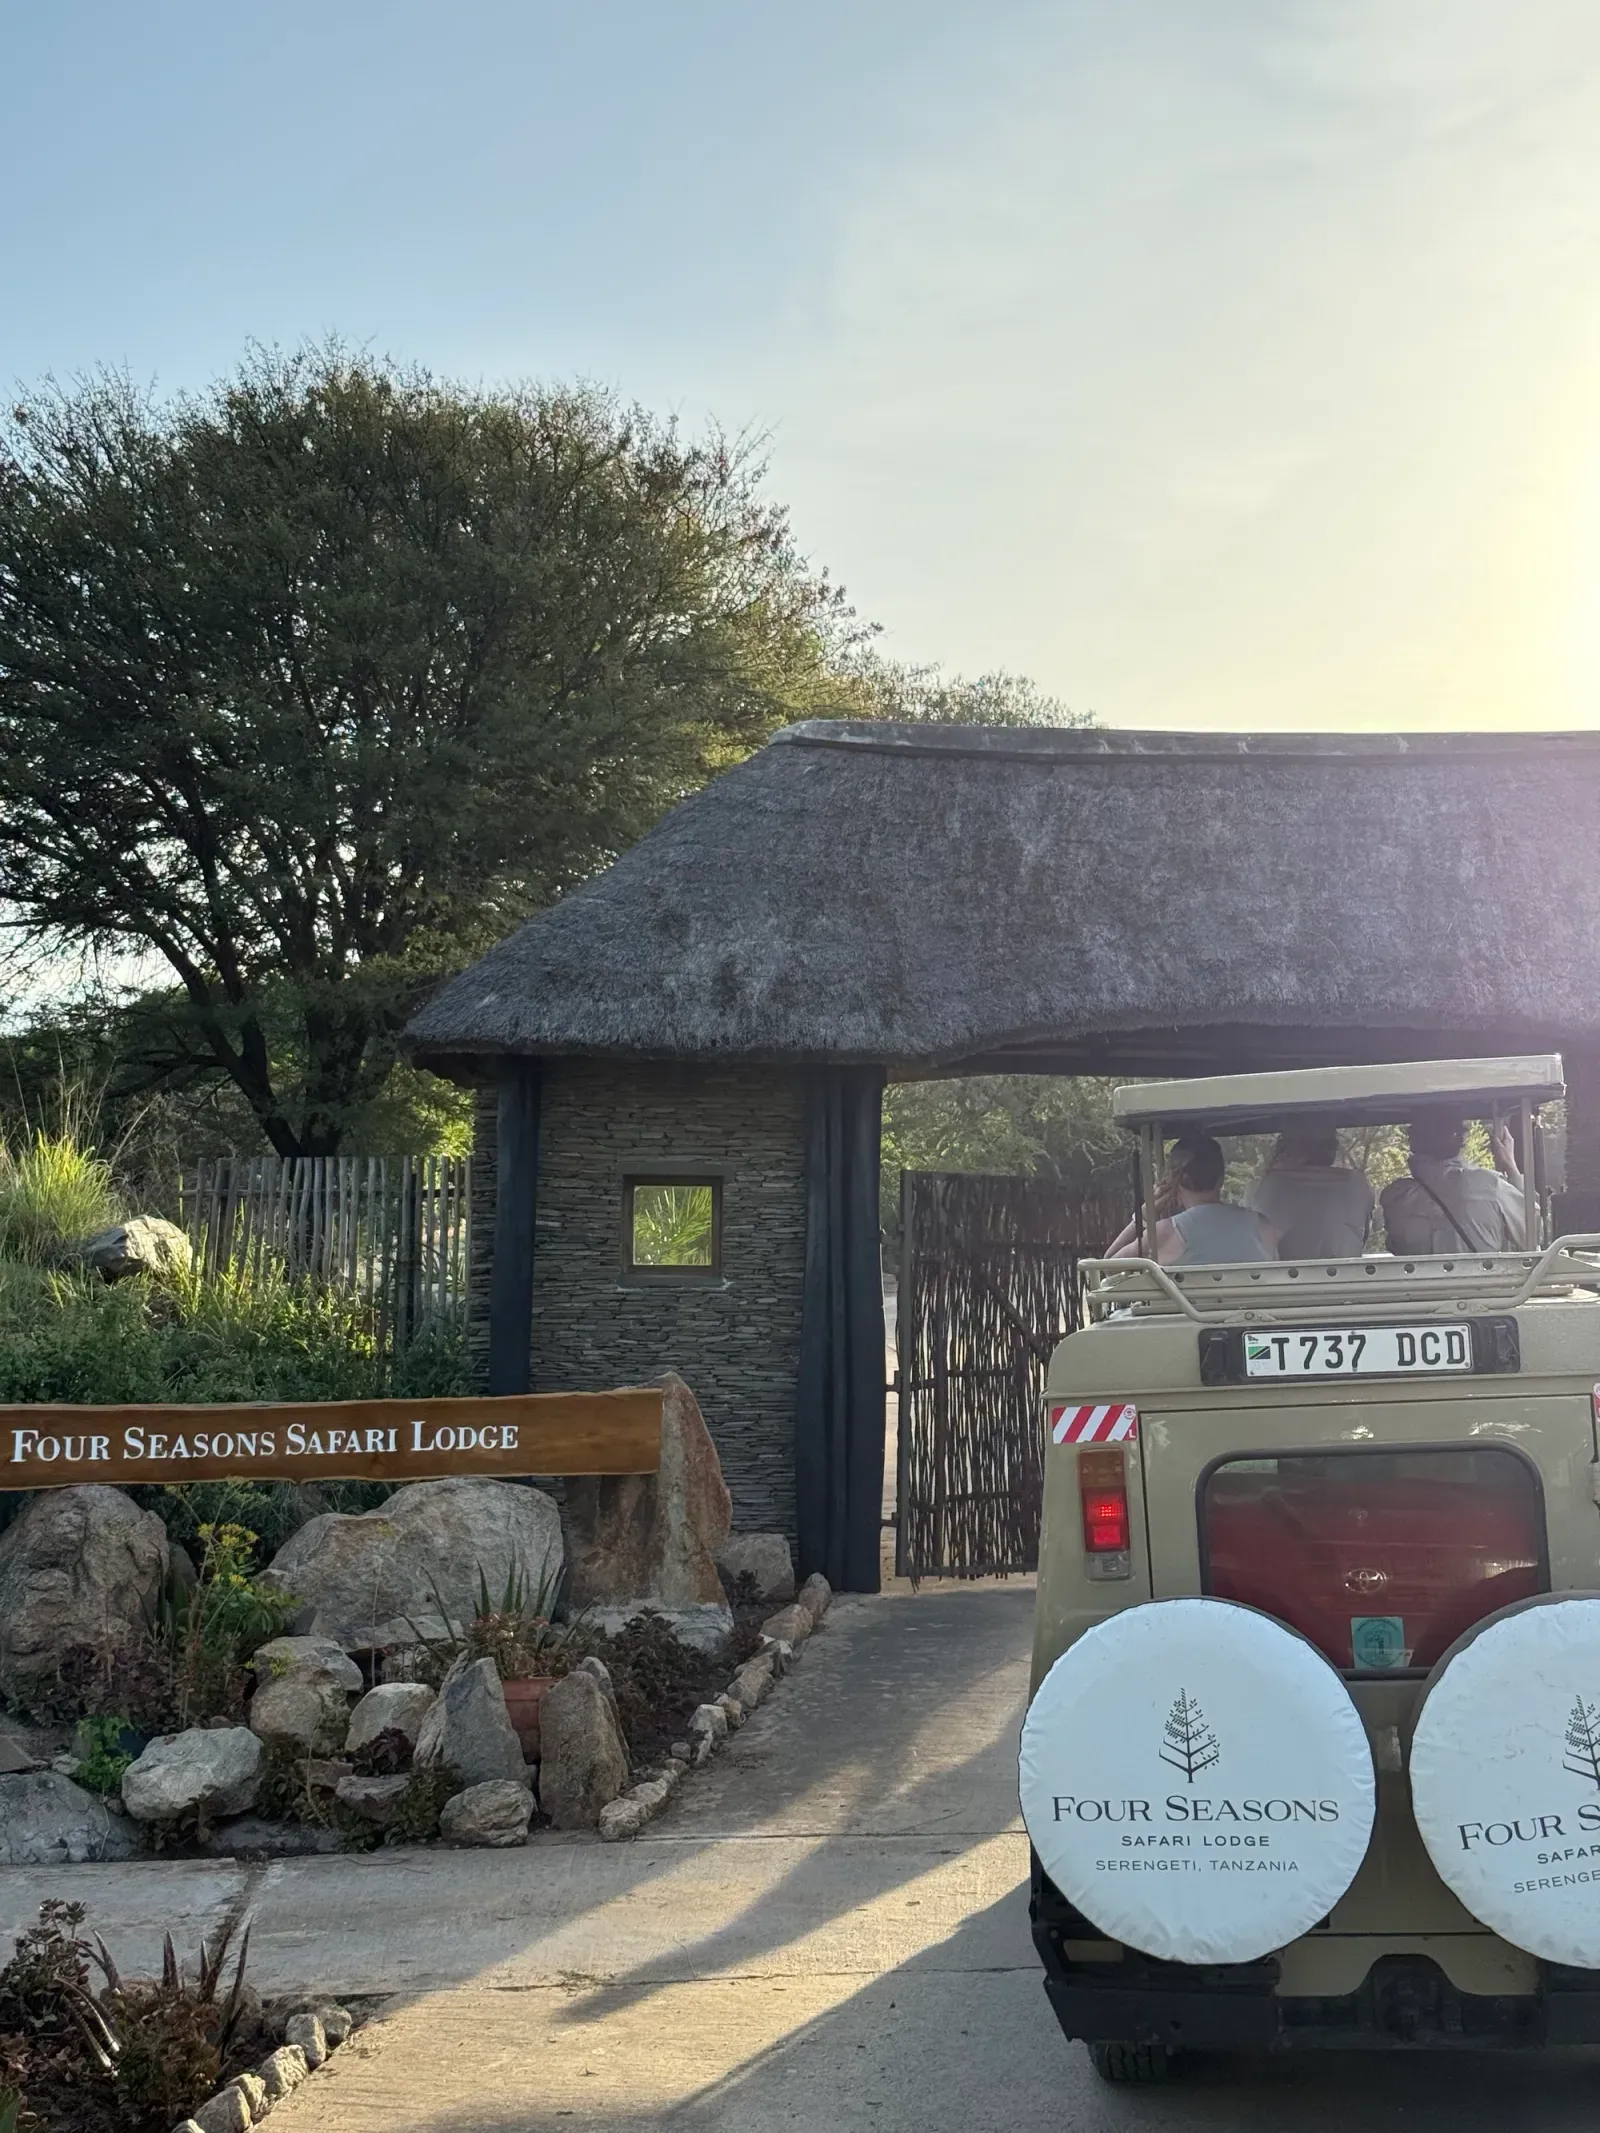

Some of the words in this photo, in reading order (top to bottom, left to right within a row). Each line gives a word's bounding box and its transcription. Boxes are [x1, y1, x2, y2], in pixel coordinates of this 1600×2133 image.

[1395, 1330, 1466, 1367] DCD
[10, 1429, 111, 1463] FOUR
[122, 1425, 276, 1460] SEASONS
[285, 1422, 398, 1456] SAFARI
[410, 1420, 520, 1452] LODGE
[1051, 1796, 1153, 1822] FOUR
[1165, 1794, 1340, 1822] SEASONS
[1121, 1835, 1191, 1847] SAFARI
[1203, 1835, 1270, 1847] LODGE
[1456, 1814, 1567, 1851] FOUR
[1095, 1859, 1201, 1872] SERENGETI,
[1208, 1859, 1299, 1872] TANZANIA
